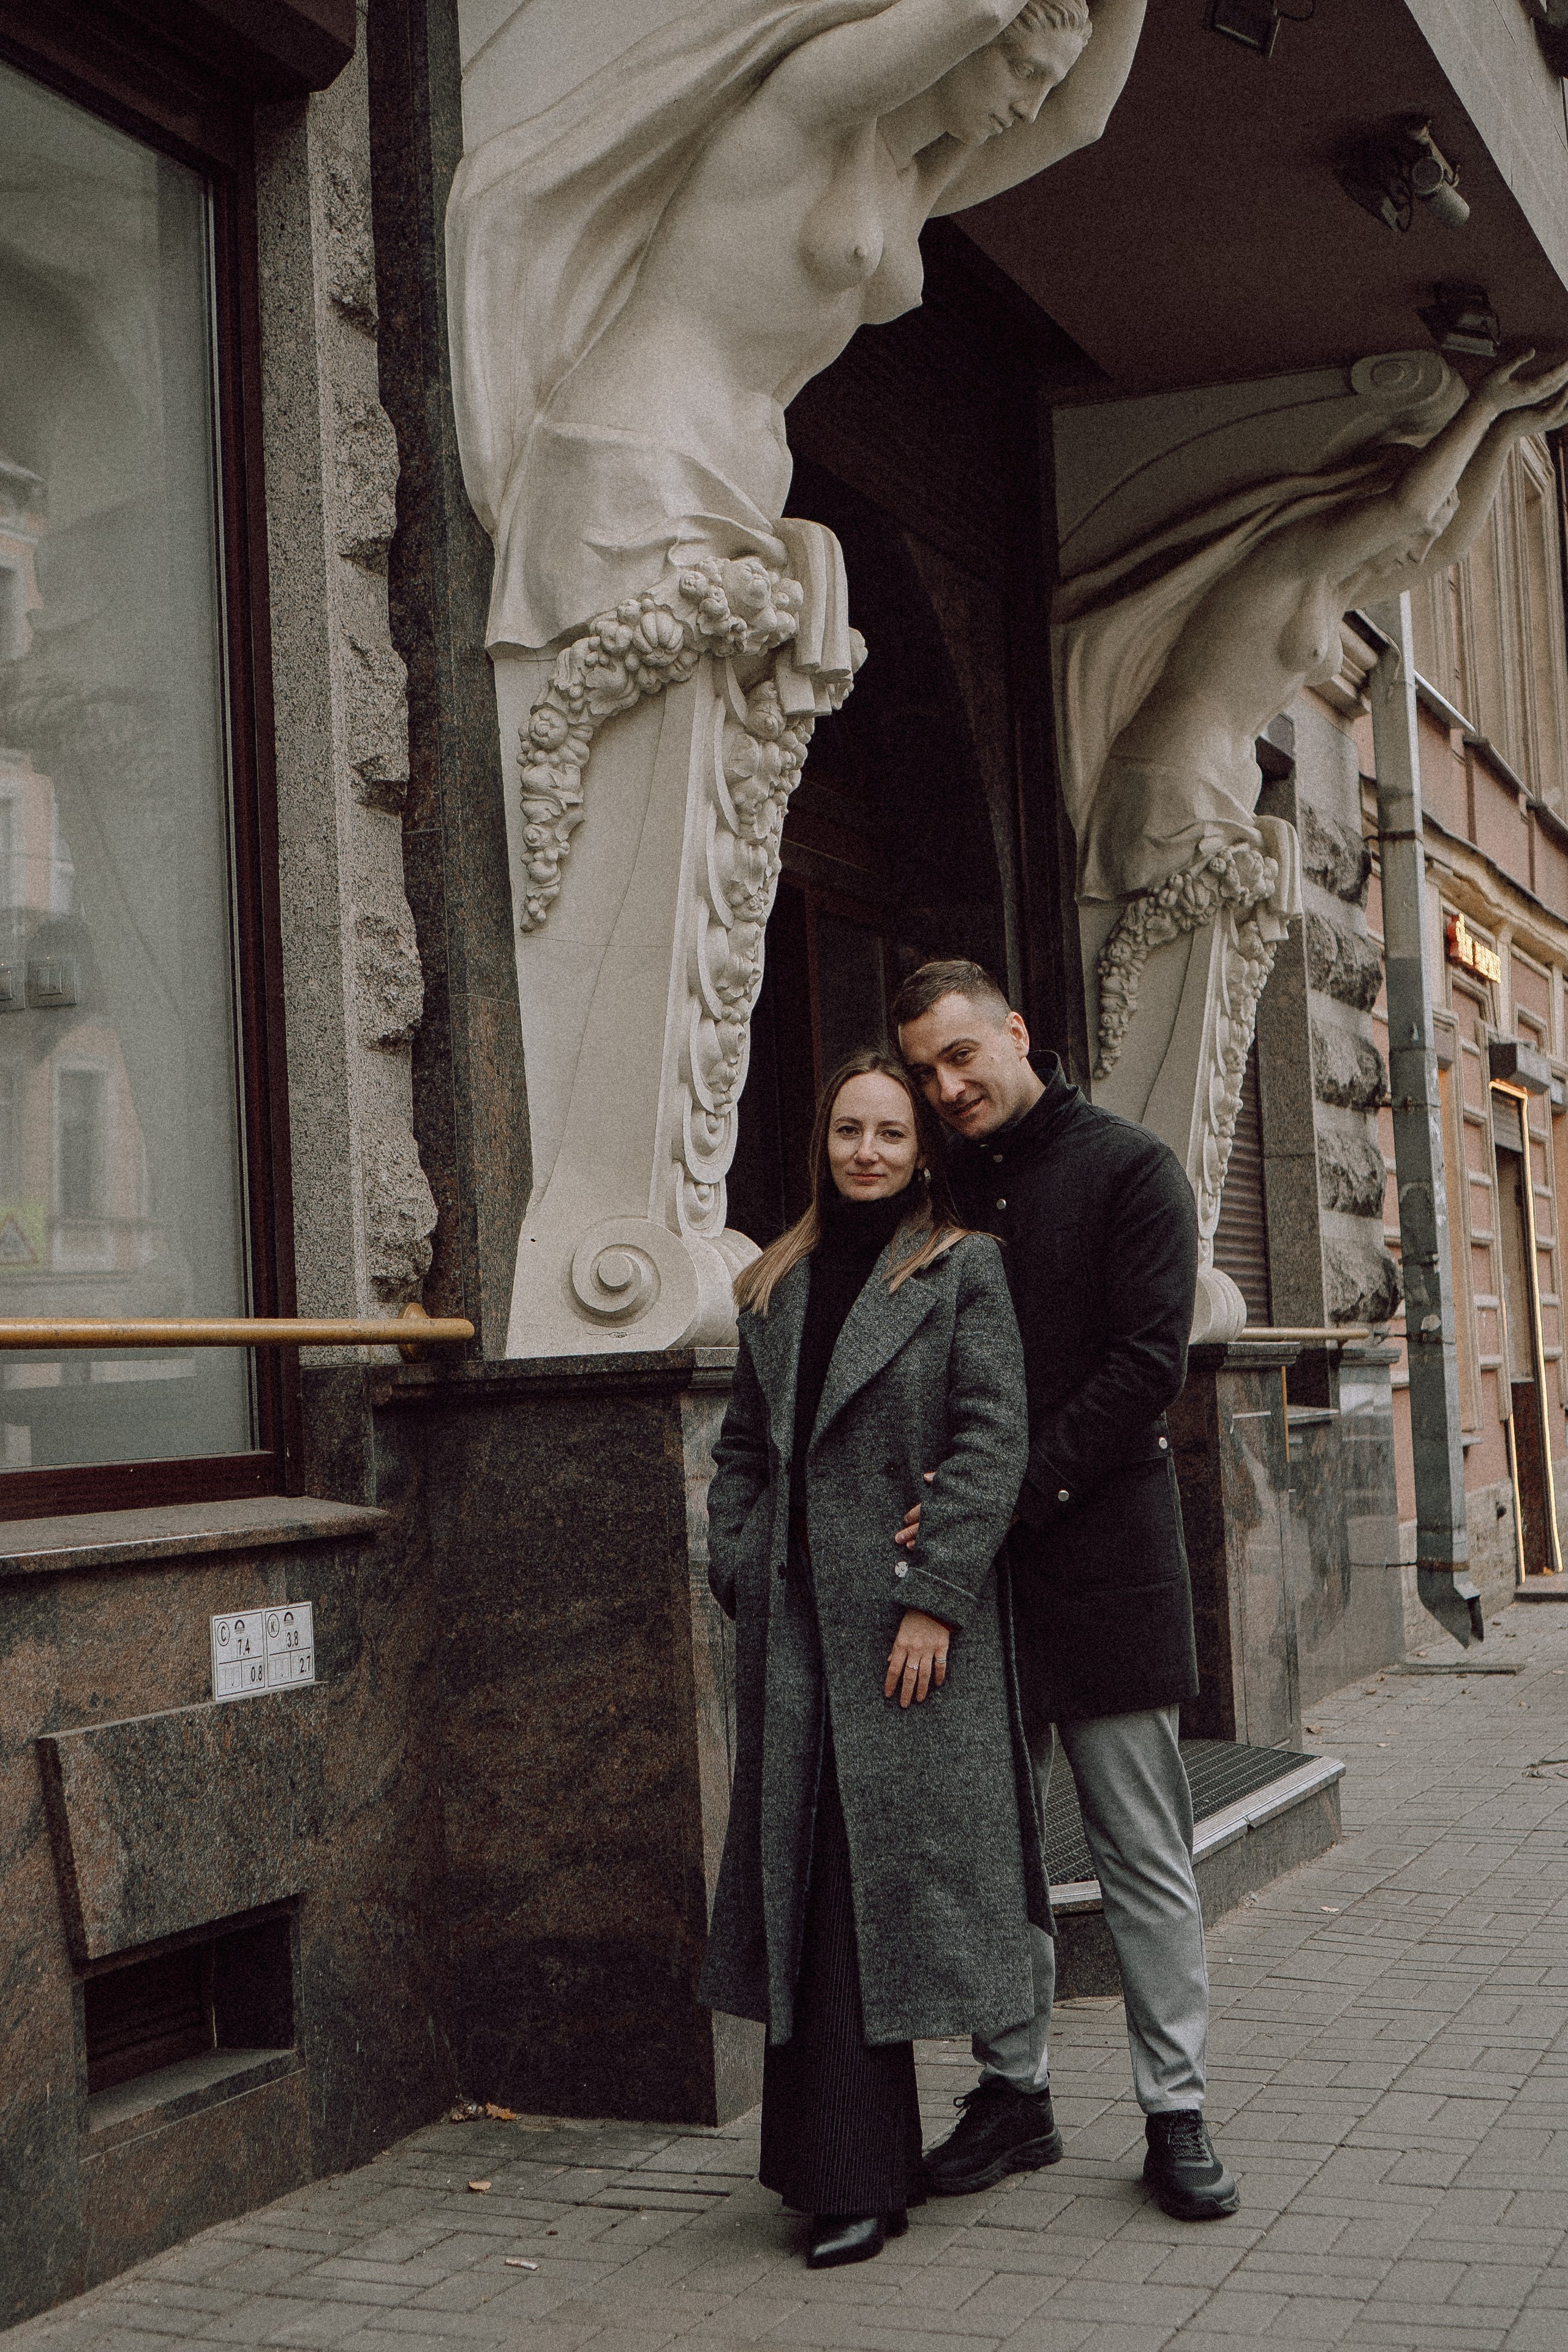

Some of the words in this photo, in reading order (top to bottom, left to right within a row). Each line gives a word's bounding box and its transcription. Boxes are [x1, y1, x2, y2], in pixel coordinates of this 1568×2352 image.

[238, 1637, 251, 1656] 7.4
[287, 1630, 299, 1648] 3.8
[300, 1655, 311, 1674] 2.7
[251, 1665, 262, 1683] 0.8
